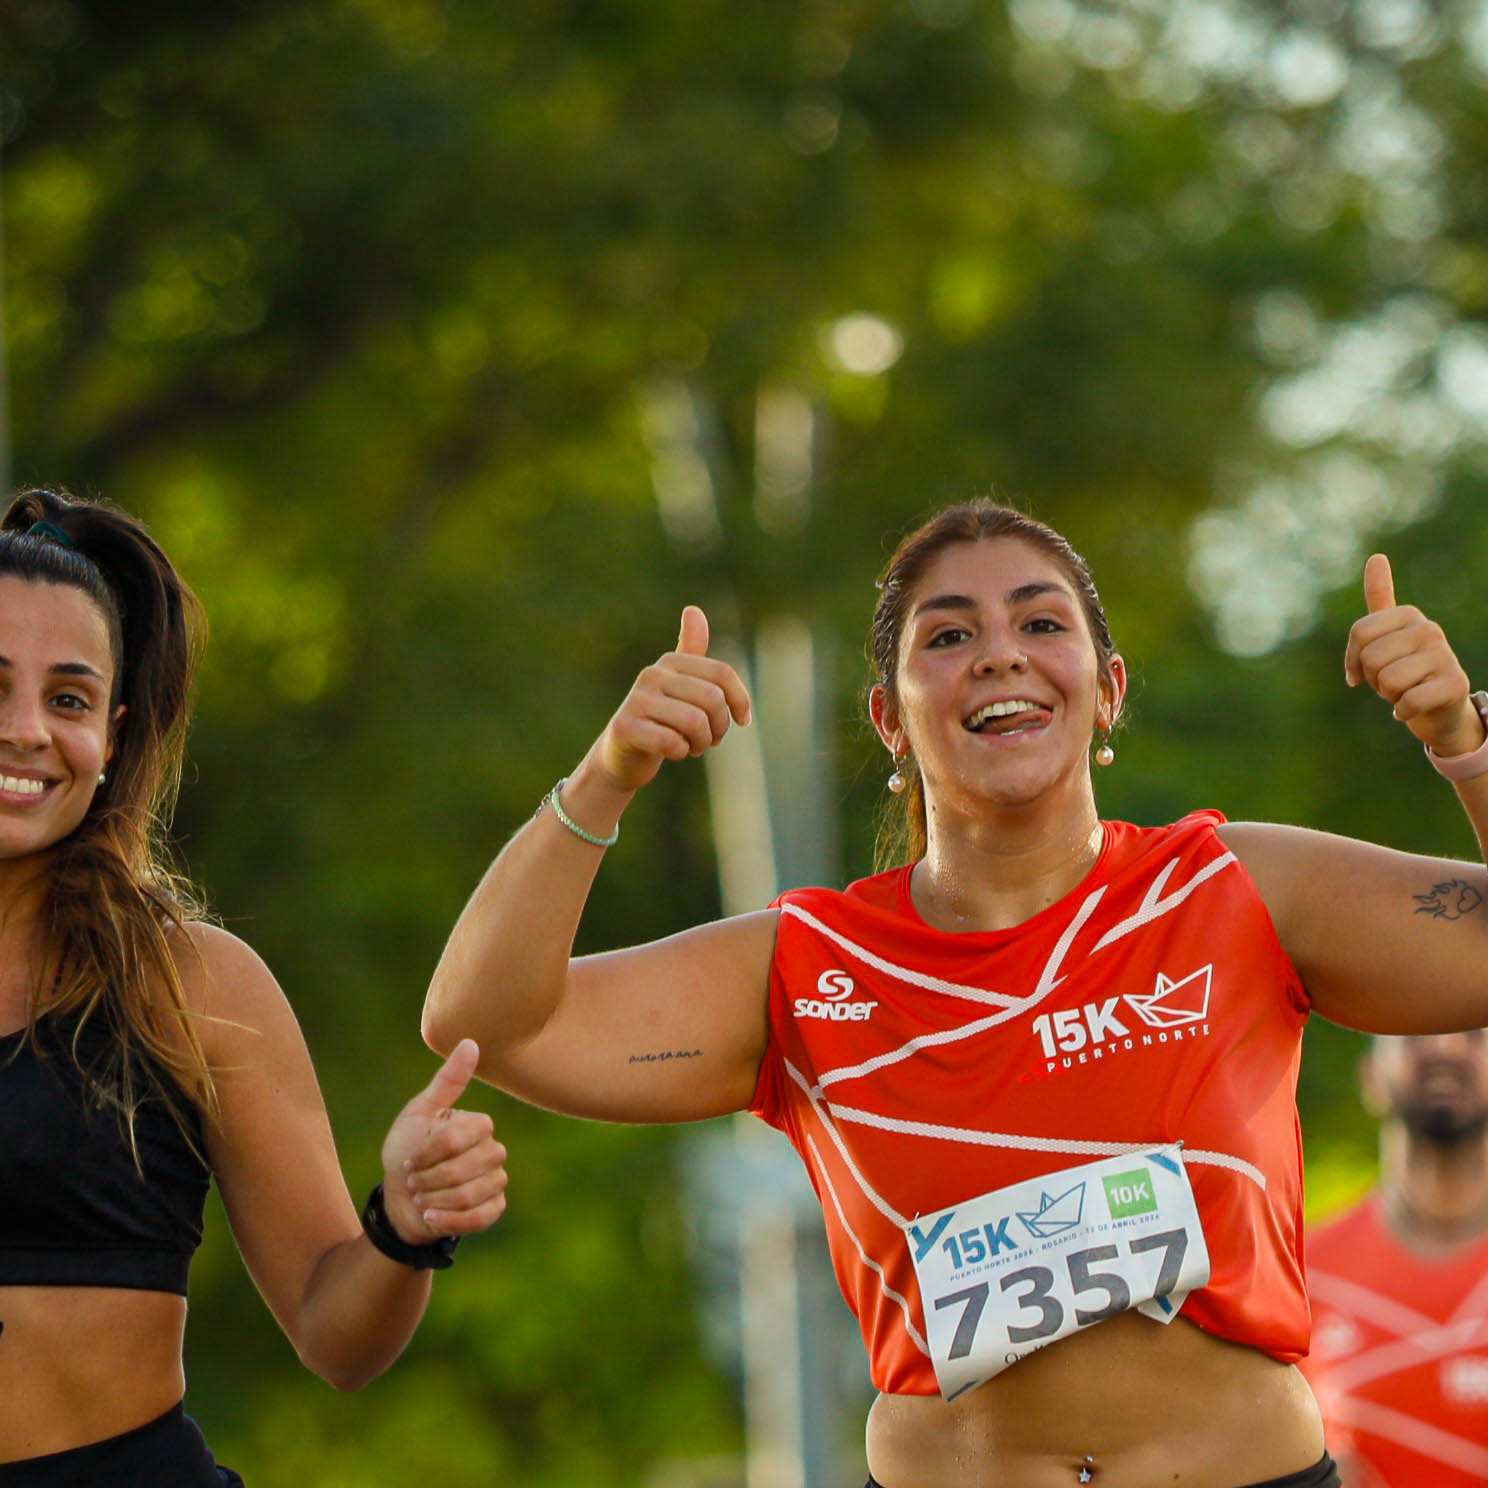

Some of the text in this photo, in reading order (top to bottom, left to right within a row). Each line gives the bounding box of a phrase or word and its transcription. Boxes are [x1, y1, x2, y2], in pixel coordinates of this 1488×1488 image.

[1032, 996, 1131, 1059] 15K
[1046, 1023, 1210, 1073] PUERTO NORTE
[1110, 1180, 1150, 1206] 10K
[942, 1215, 1019, 1270] 15K
[933, 1227, 1189, 1361] 7357
